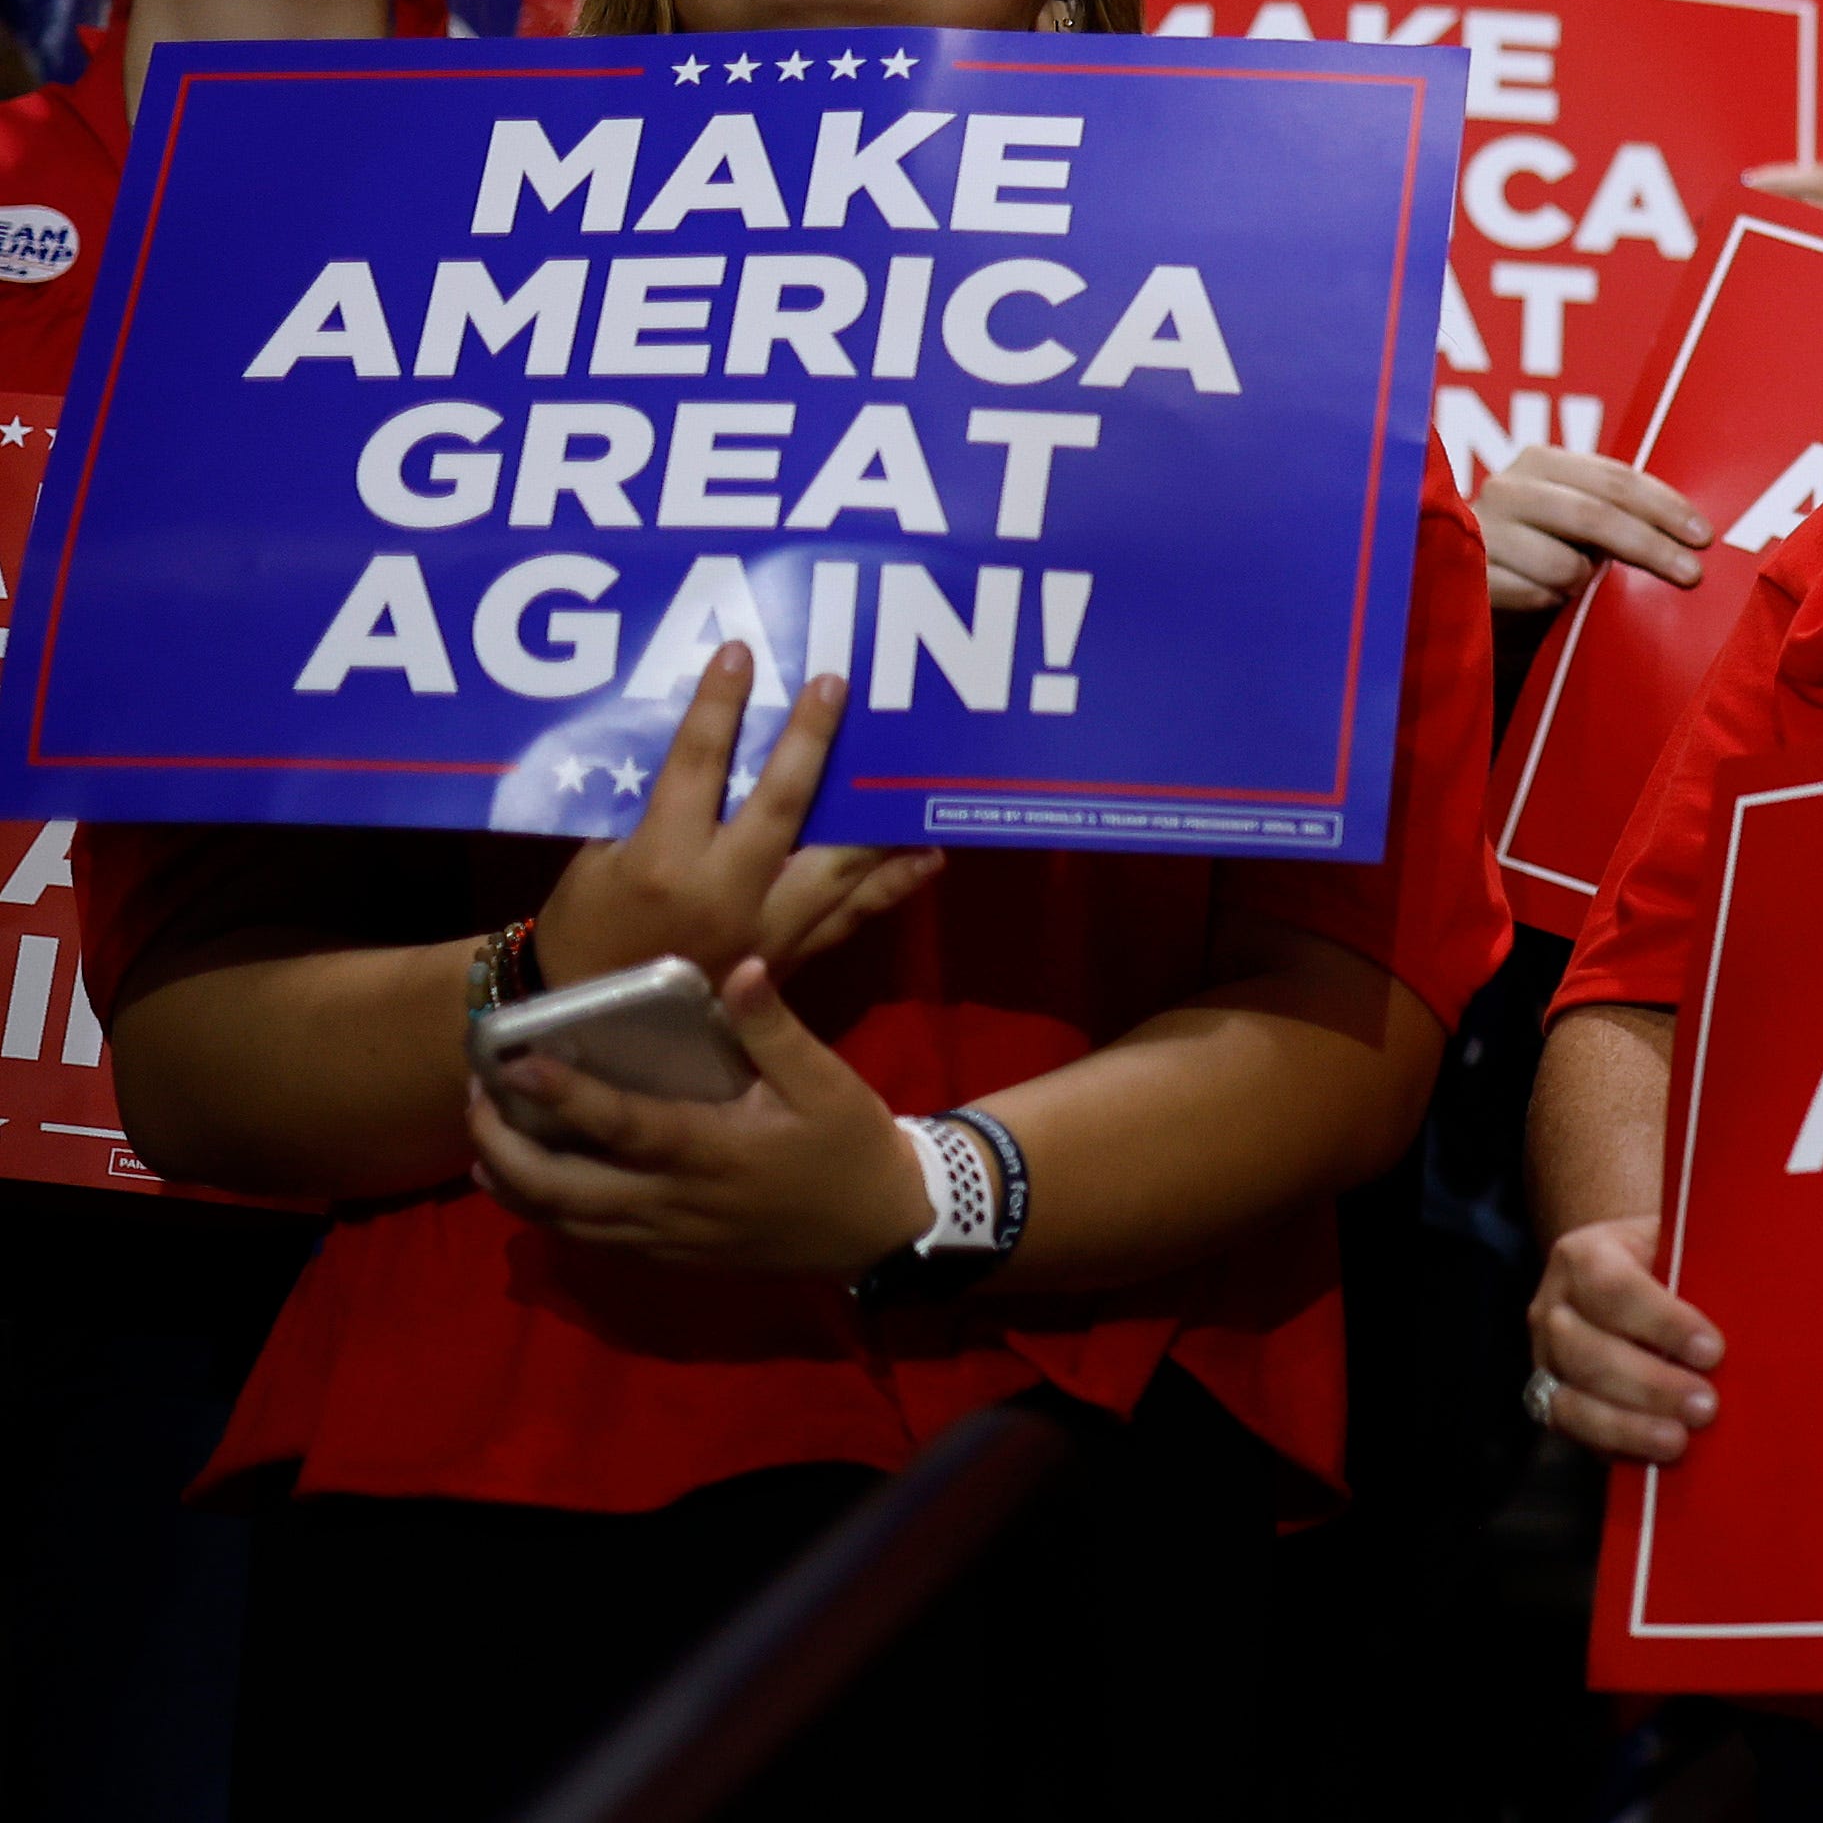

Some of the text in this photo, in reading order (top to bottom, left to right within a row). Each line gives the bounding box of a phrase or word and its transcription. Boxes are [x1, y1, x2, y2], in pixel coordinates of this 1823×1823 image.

[471, 111, 1084, 235] MAKE
[242, 255, 1242, 394] AMERICA
[357, 402, 1101, 539] GREAT
[294, 551, 1092, 714] AGAIN!
